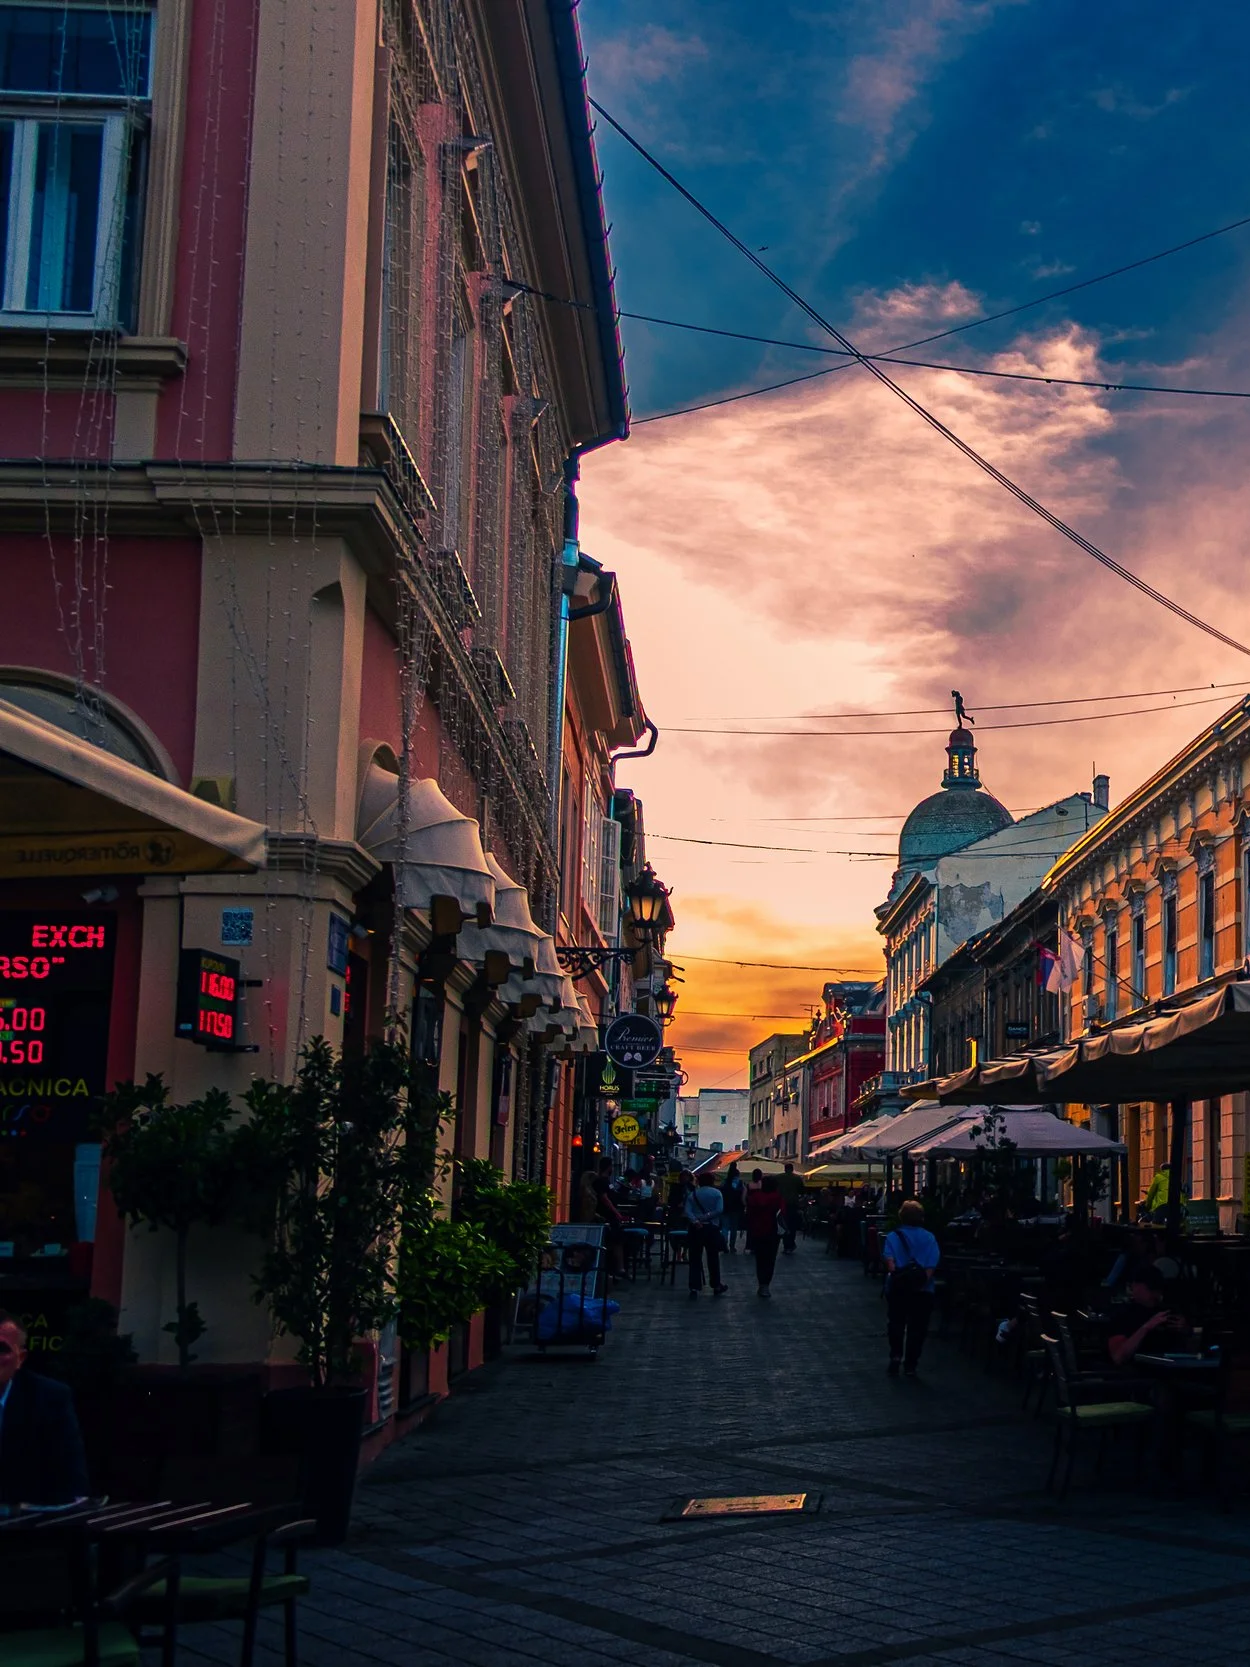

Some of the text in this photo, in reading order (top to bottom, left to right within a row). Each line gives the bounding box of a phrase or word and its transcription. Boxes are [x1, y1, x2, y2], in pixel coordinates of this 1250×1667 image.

[31, 924, 105, 949] EXCH
[0, 1007, 45, 1031] .00
[0, 1040, 43, 1064] .50
